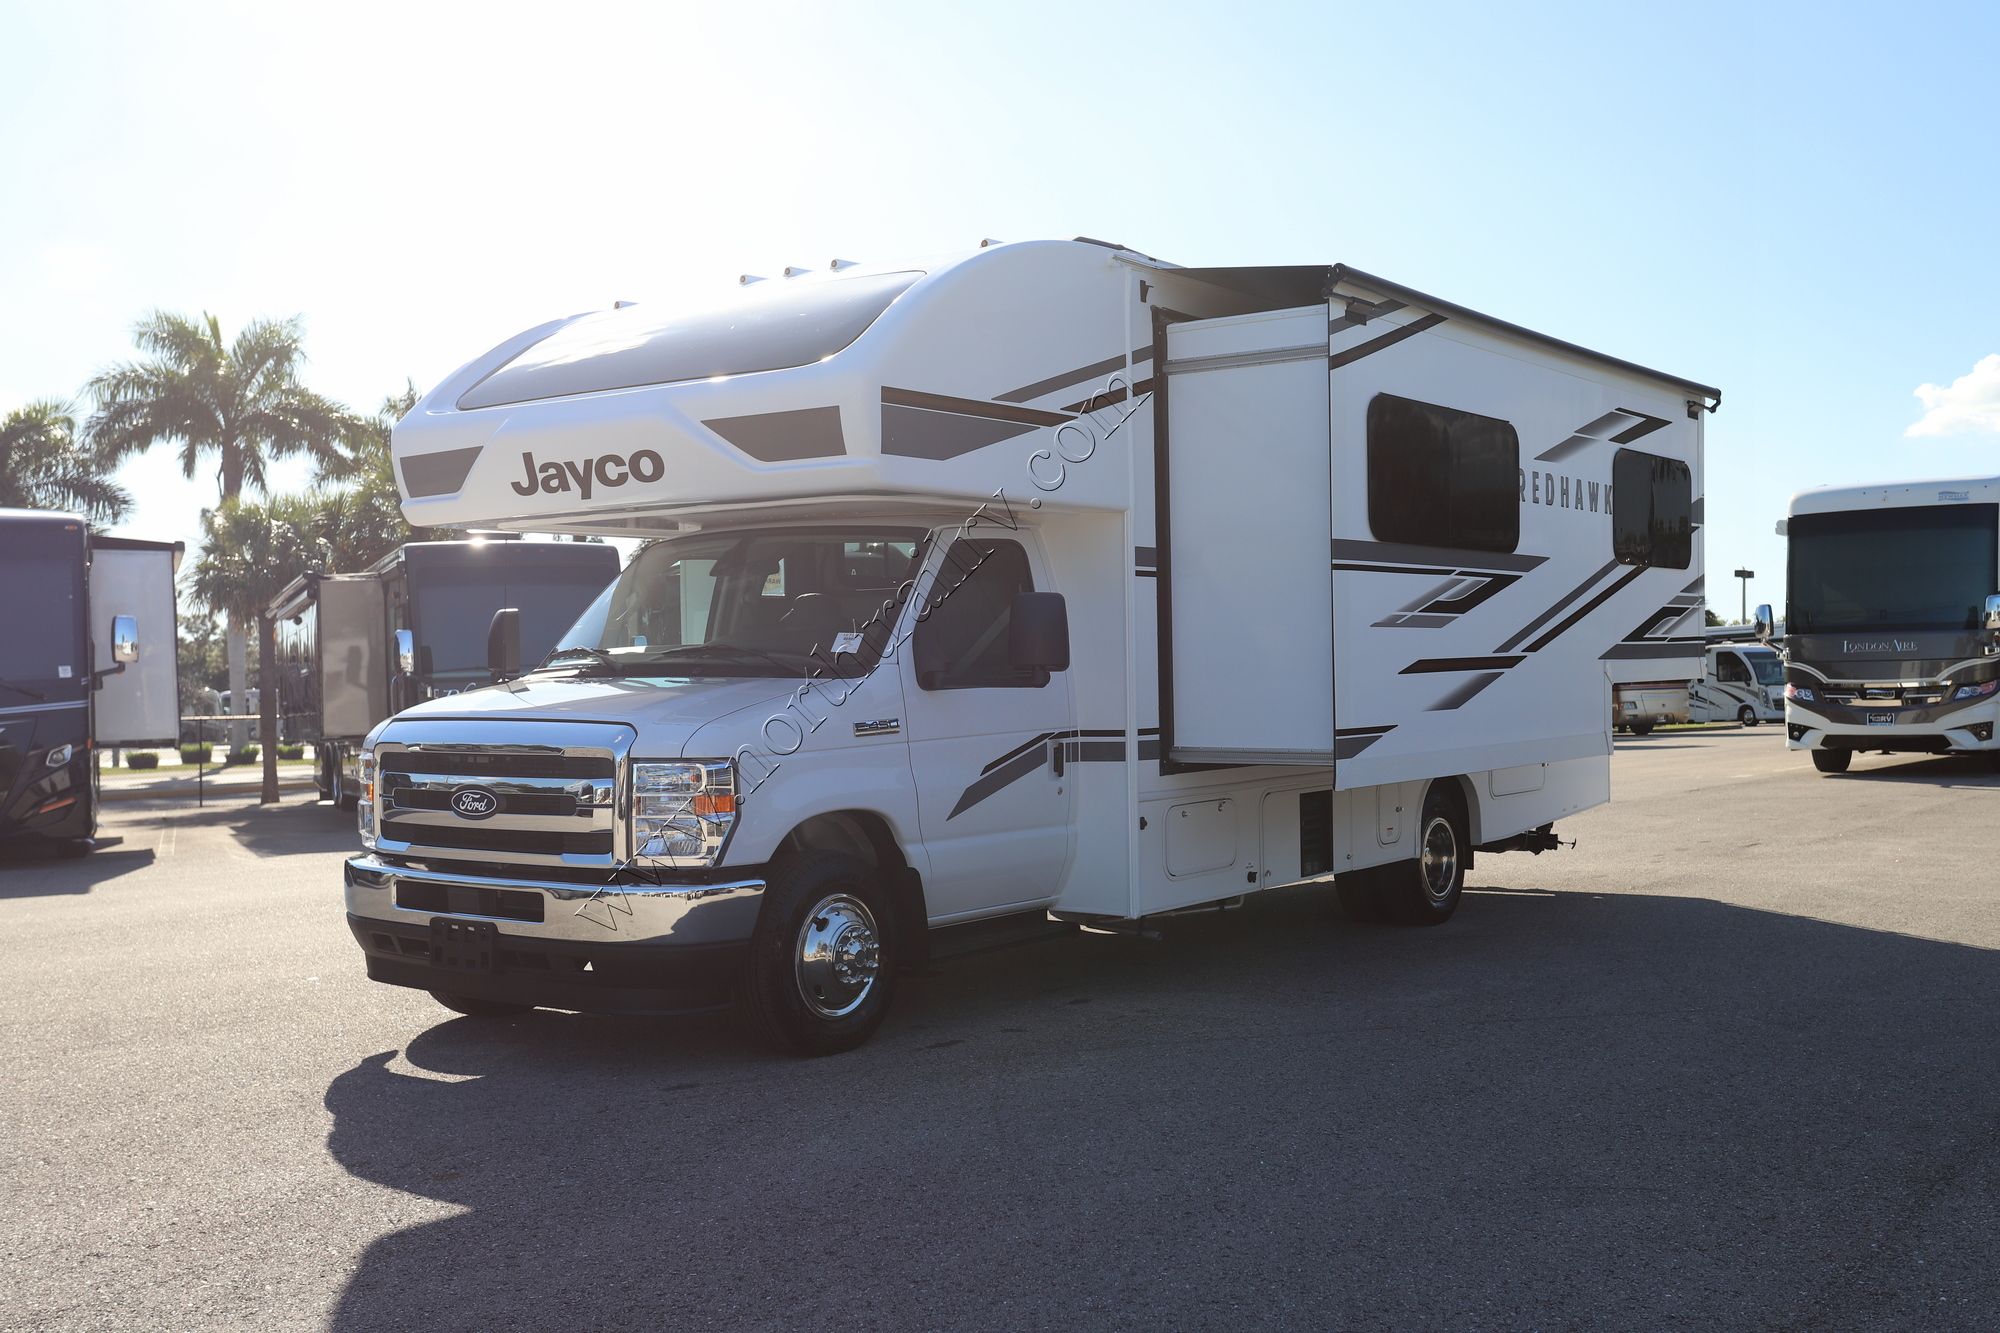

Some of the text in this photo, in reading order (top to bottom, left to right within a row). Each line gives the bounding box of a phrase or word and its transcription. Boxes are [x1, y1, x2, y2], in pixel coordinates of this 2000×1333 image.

[511, 449, 665, 500] Jayco
[1519, 467, 1613, 515] REDHAWK
[460, 793, 487, 811] Ford
